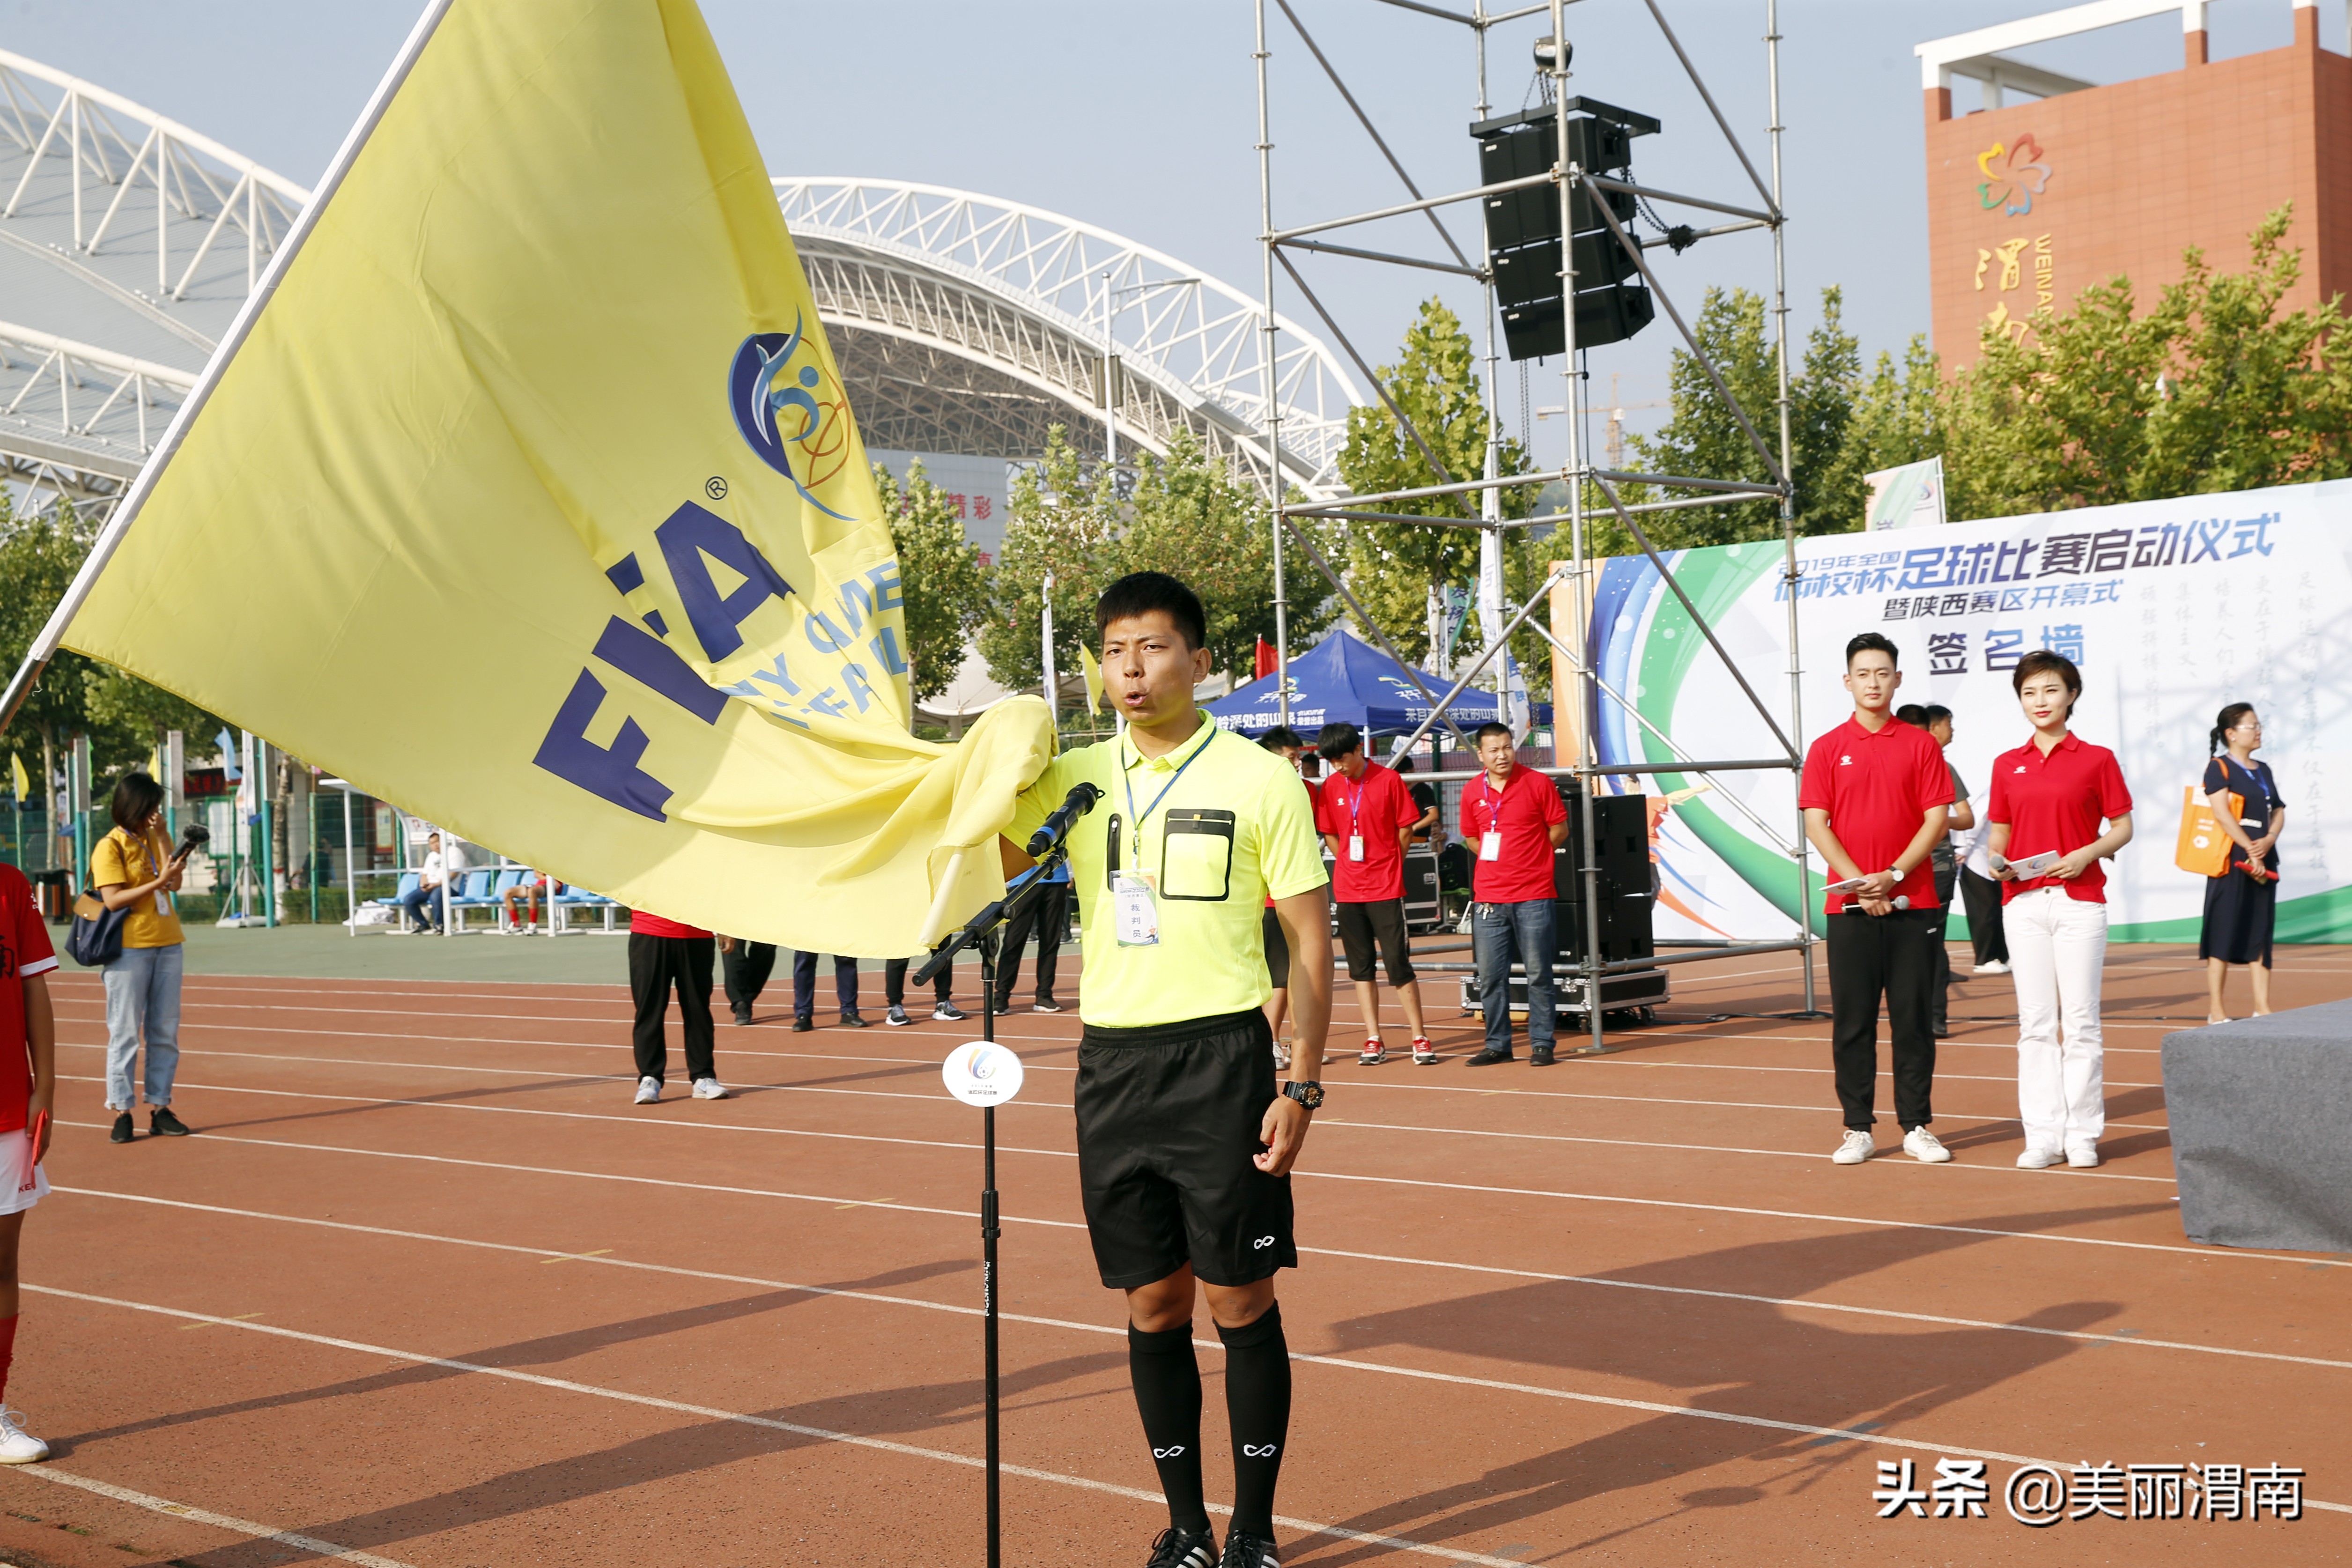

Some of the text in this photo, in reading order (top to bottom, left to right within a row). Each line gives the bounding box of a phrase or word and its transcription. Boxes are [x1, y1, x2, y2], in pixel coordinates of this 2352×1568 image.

[1895, 512, 2281, 591] 足球比赛启动仪式
[1881, 578, 2124, 621] 暨陕西赛区开幕式
[532, 499, 796, 823] FIA
[1928, 624, 2084, 675] 签名墙
[1131, 904, 1141, 938] 裁判员
